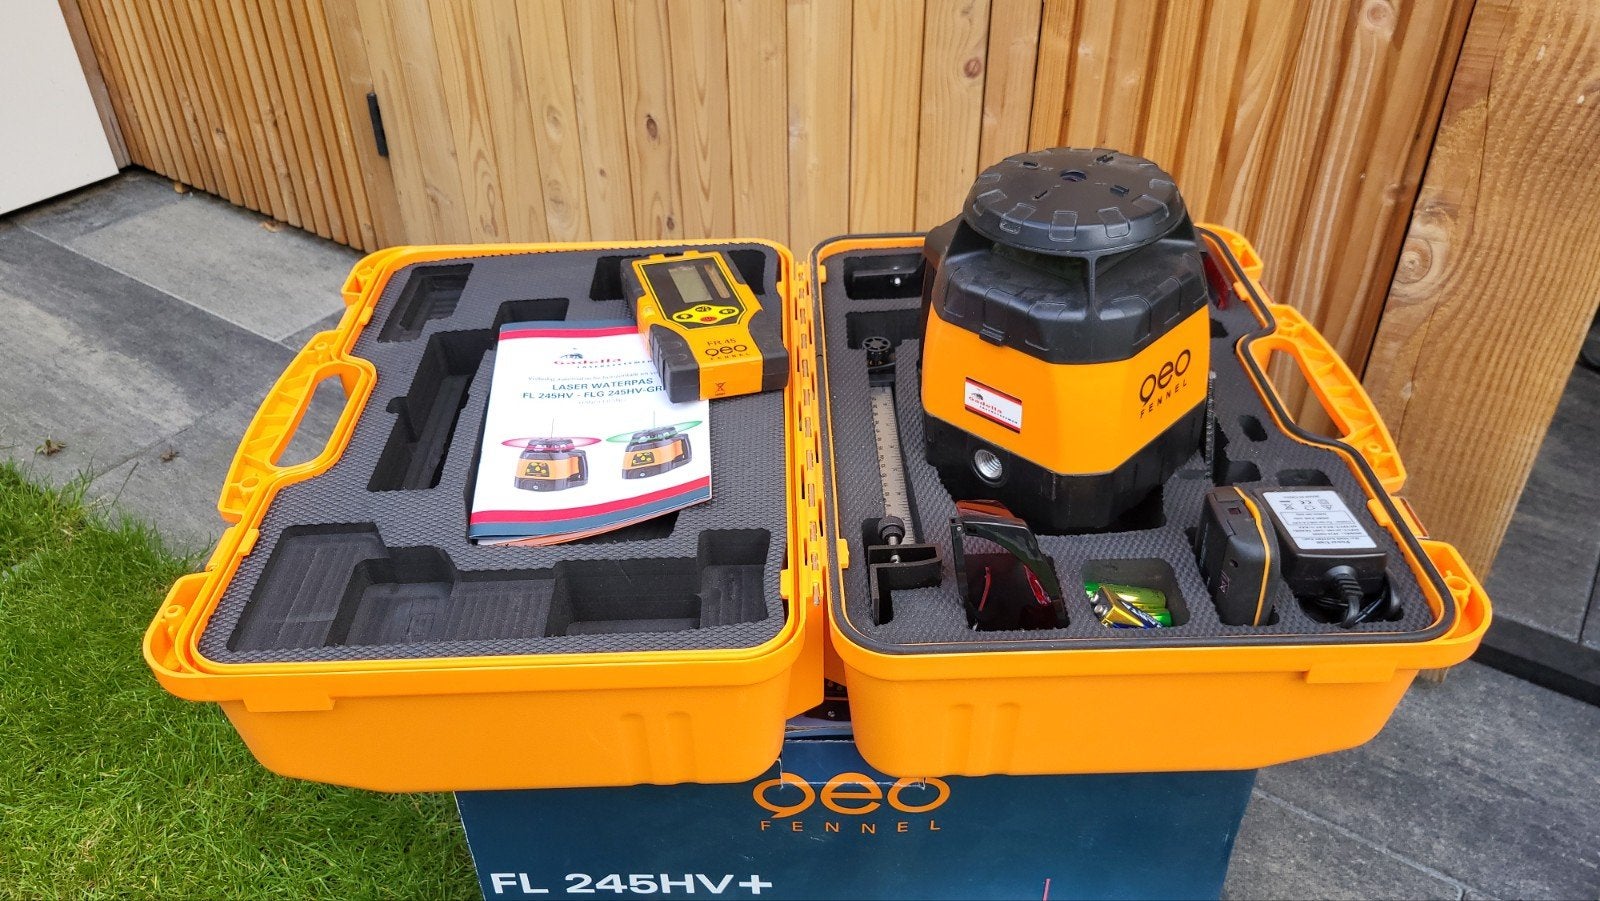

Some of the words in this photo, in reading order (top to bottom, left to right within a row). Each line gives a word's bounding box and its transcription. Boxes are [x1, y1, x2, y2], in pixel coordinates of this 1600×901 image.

[705, 344, 747, 356] geo
[552, 383, 588, 391] LASER
[591, 378, 653, 389] WATERPAS
[1139, 349, 1191, 407] geo
[584, 390, 604, 398] FLG
[1140, 379, 1187, 419] FENNEL
[752, 772, 951, 819] geo
[760, 820, 942, 834] FENNEL
[490, 873, 549, 894] FL
[564, 873, 773, 895] 245HV+
